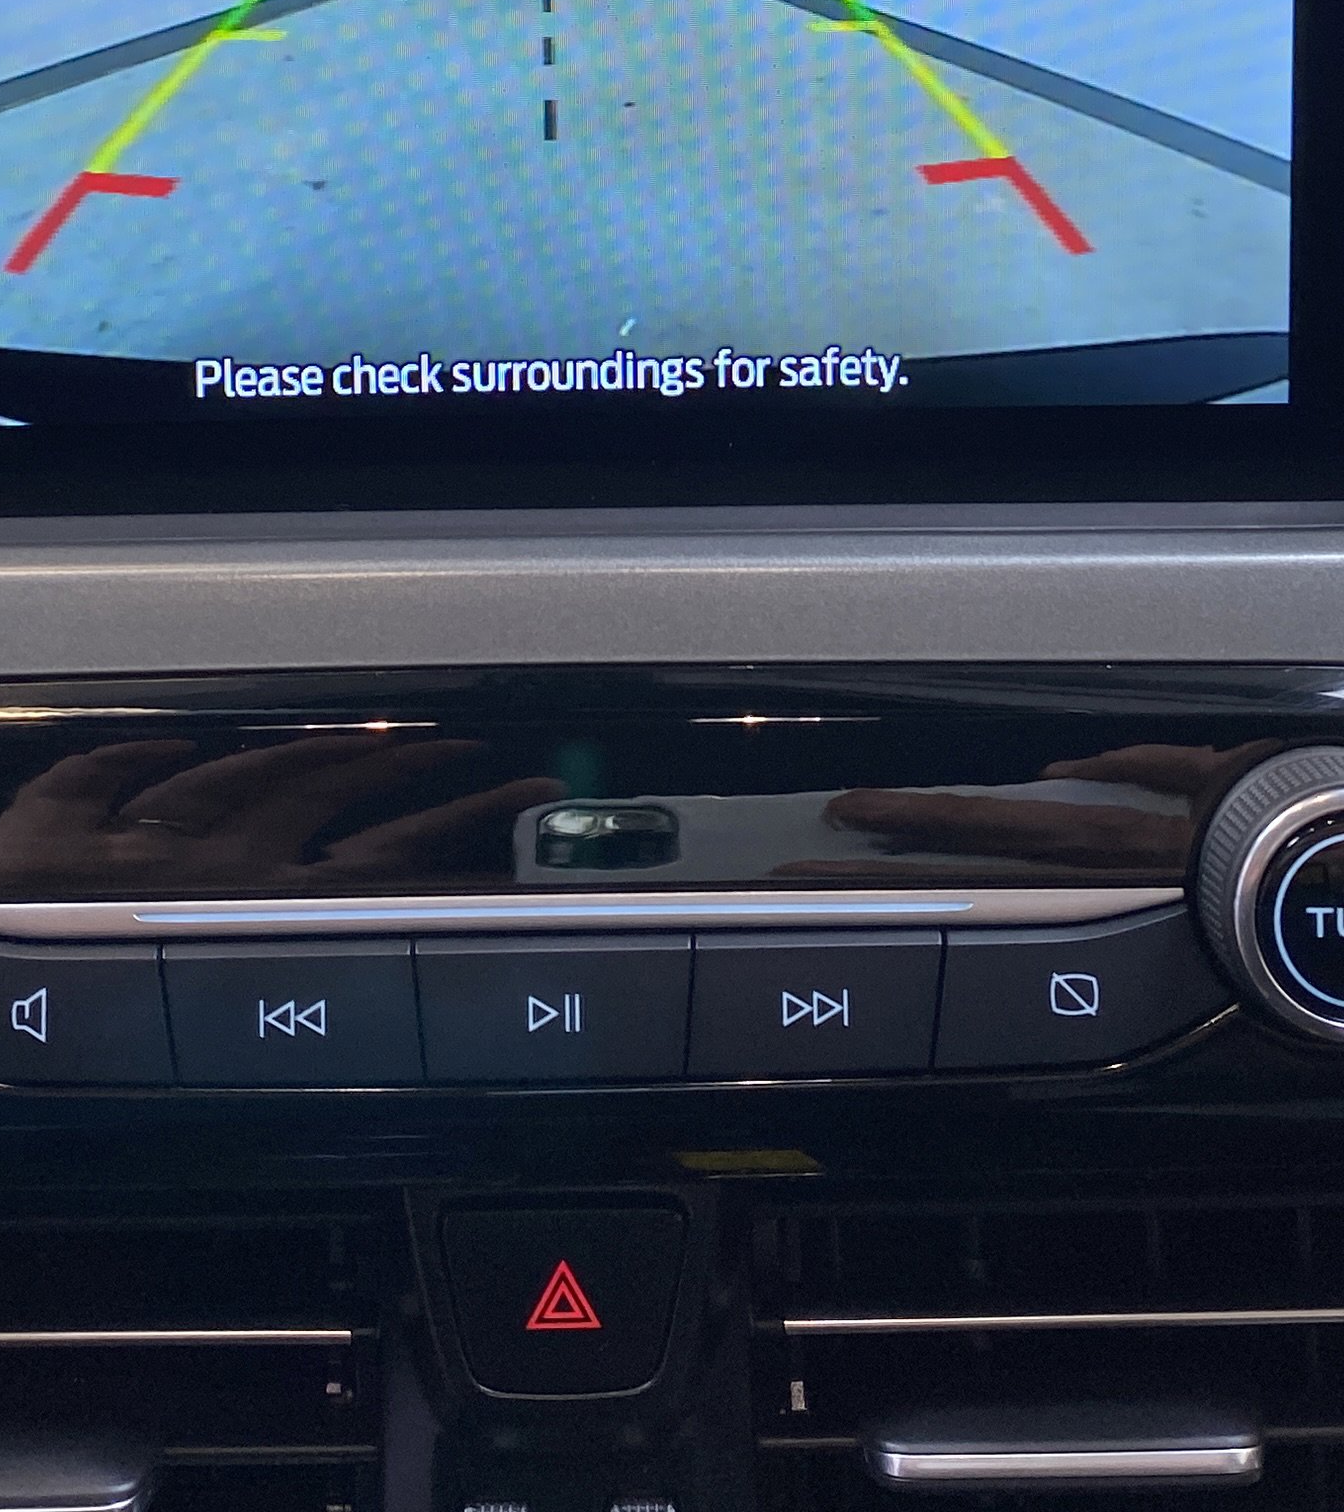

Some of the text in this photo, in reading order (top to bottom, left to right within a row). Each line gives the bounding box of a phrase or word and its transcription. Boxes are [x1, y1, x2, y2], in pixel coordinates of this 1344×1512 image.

[195, 346, 909, 398] Please check surroundings for safety.
